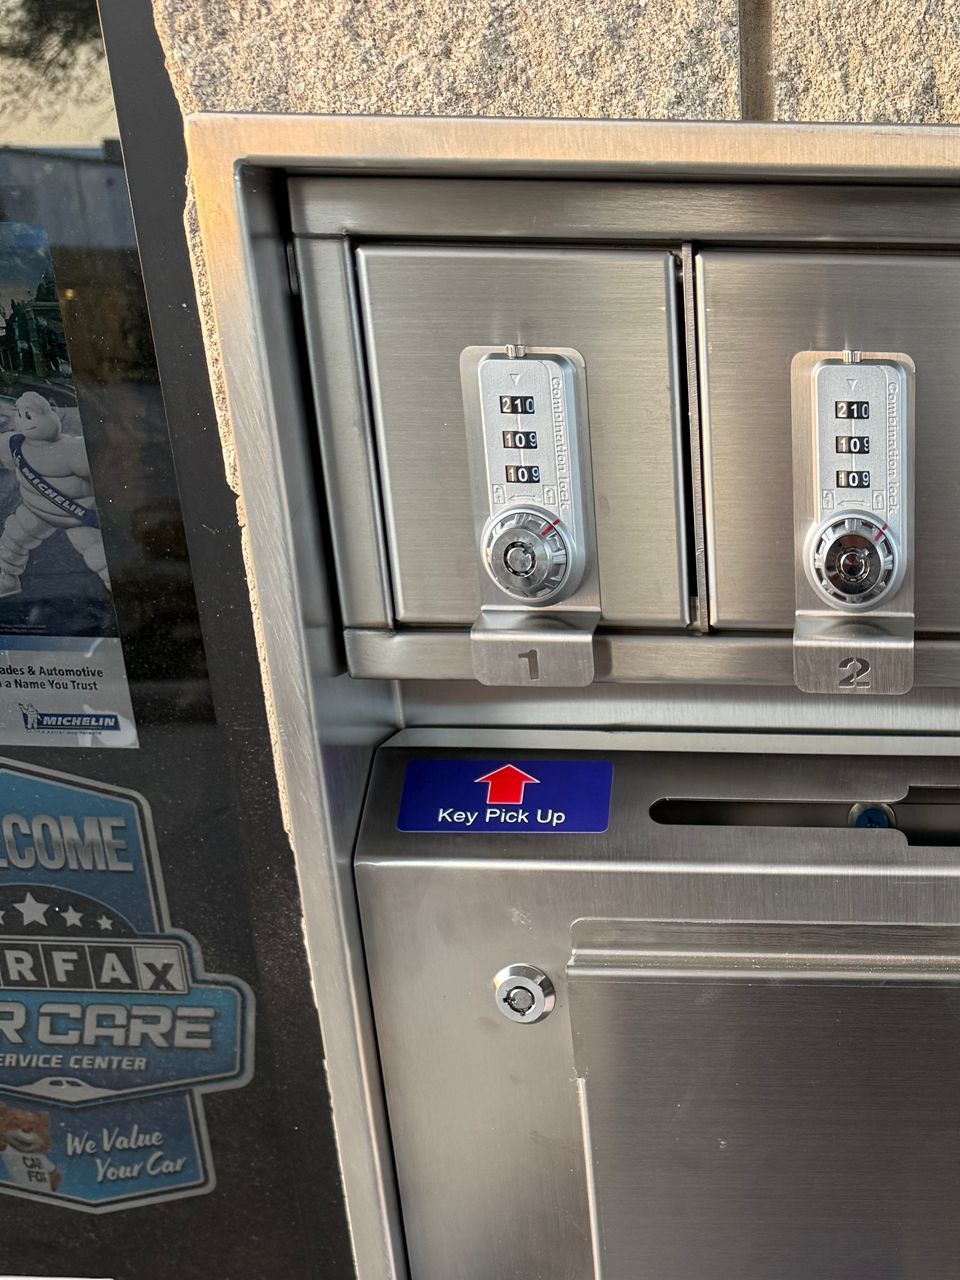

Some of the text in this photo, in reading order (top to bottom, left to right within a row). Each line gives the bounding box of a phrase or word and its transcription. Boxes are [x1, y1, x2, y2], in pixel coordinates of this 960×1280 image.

[22, 467, 85, 517] MICHELIN
[27, 665, 35, 675] &
[39, 666, 104, 677] Automotive
[518, 649, 539, 680] 1
[838, 657, 871, 688] 2
[15, 679, 46, 689] Name
[48, 680, 68, 689] You
[71, 681, 98, 690] Trust
[43, 716, 115, 726] MICHELIN
[438, 808, 566, 826] Key Pick Up
[0, 814, 134, 871] COME
[38, 1003, 215, 1048] CARE
[69, 1055, 147, 1070] CENTER
[66, 1124, 164, 1156] We Value
[96, 1151, 187, 1182] Your Car
